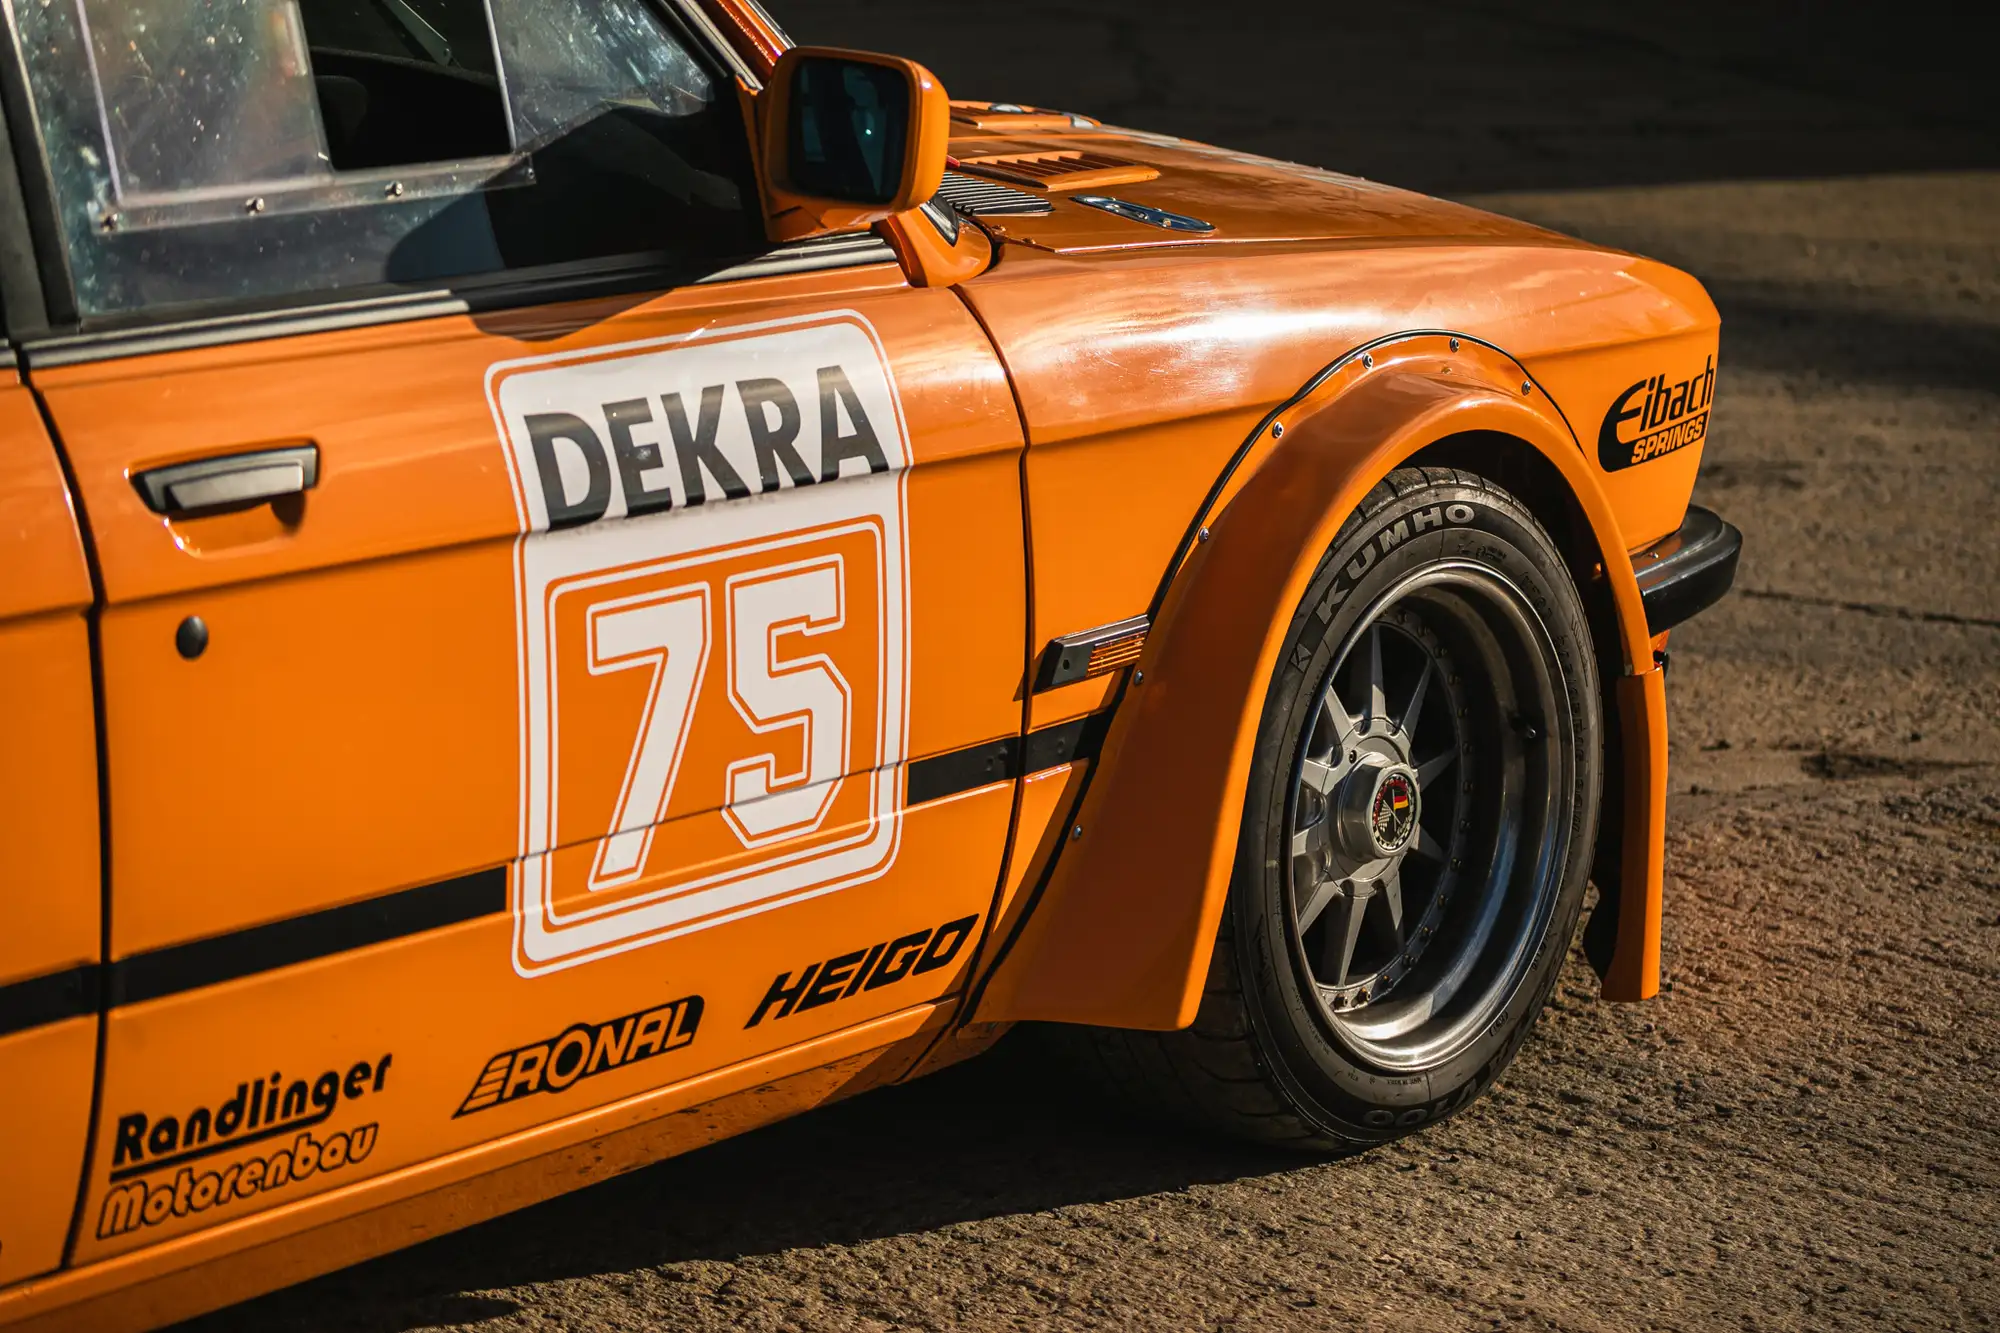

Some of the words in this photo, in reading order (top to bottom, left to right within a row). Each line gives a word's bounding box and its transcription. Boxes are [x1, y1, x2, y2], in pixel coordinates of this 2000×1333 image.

[523, 364, 890, 532] DEKRA
[1598, 354, 1715, 462] Eibach
[1631, 415, 1705, 464] SPRINGS
[1315, 503, 1476, 625] KUMHO
[586, 553, 852, 892] 75
[743, 913, 980, 1030] HEIGO
[499, 996, 703, 1096] RONAL
[110, 1053, 393, 1172] Randlinger
[97, 1123, 379, 1240] Motorenbau
